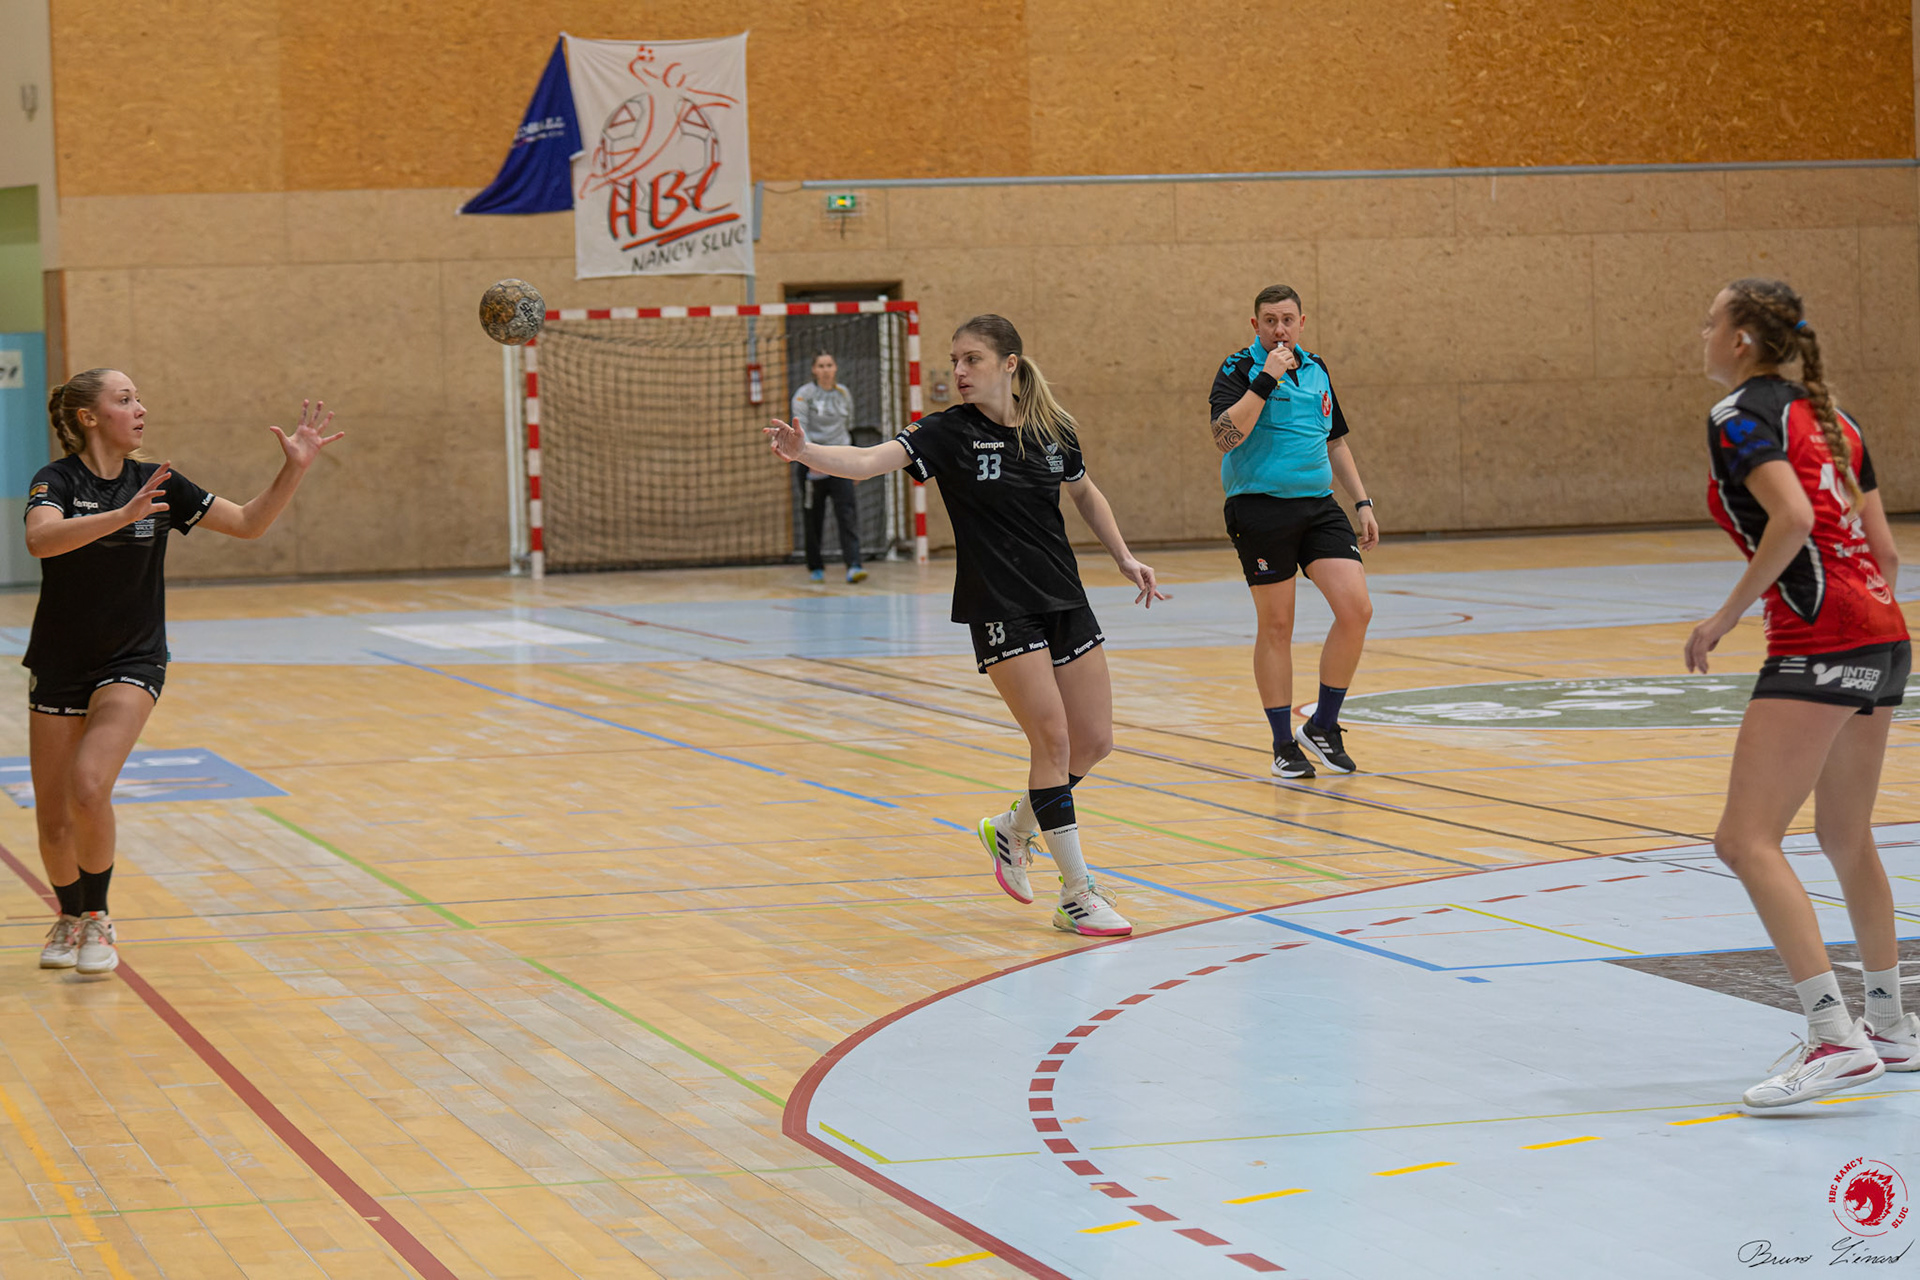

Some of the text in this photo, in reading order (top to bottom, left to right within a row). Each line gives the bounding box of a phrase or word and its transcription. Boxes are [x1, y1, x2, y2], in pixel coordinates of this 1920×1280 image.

[609, 162, 732, 240] HBC
[632, 224, 747, 272] NANCY SLUC
[973, 440, 1005, 451] Kempa
[976, 453, 1002, 481] 33
[985, 621, 1006, 647] 33
[1001, 646, 1024, 658] Kempa
[1073, 639, 1094, 655] Kempa
[1843, 665, 1881, 682] INTER
[1840, 677, 1878, 692] SPORT
